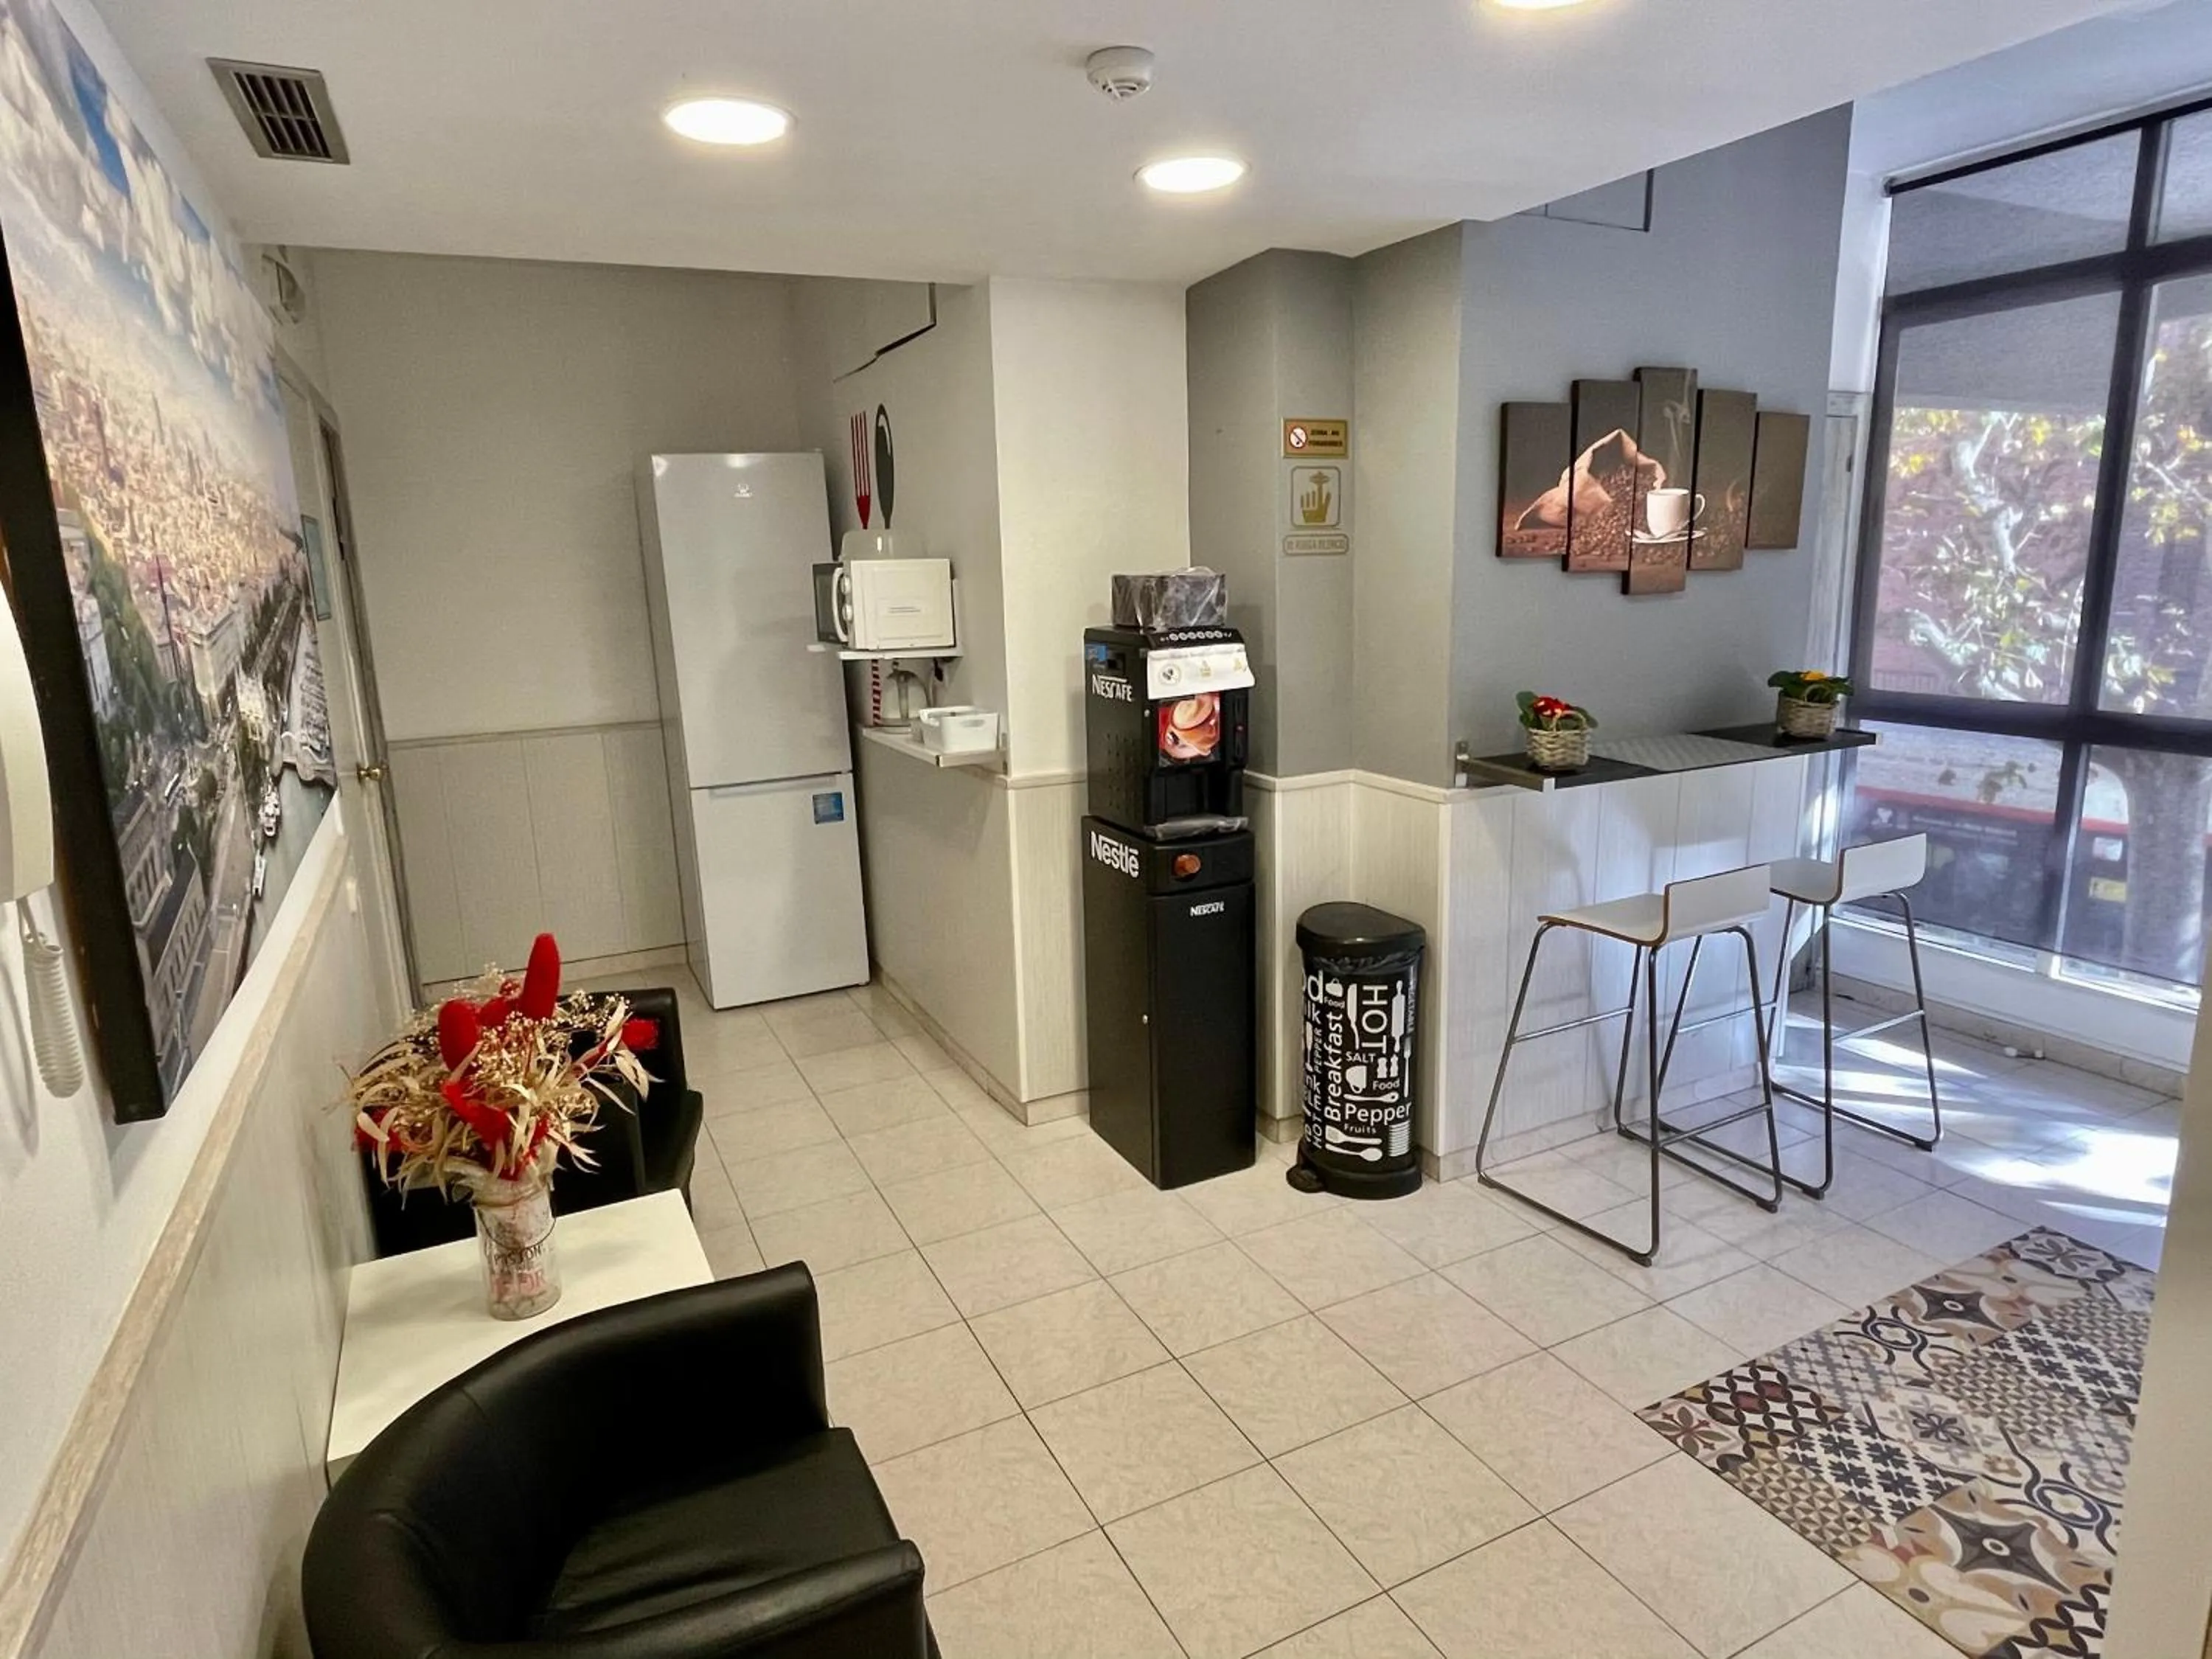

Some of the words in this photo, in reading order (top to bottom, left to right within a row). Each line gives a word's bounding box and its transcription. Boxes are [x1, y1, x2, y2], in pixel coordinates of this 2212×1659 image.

[1362, 984, 1388, 1054] HOT
[1324, 1011, 1343, 1121] Breakfast
[1346, 1051, 1377, 1063] SALT
[1372, 1077, 1400, 1091] Food
[1345, 1102, 1412, 1126] Pepper
[1344, 1123, 1377, 1134] Fruits
